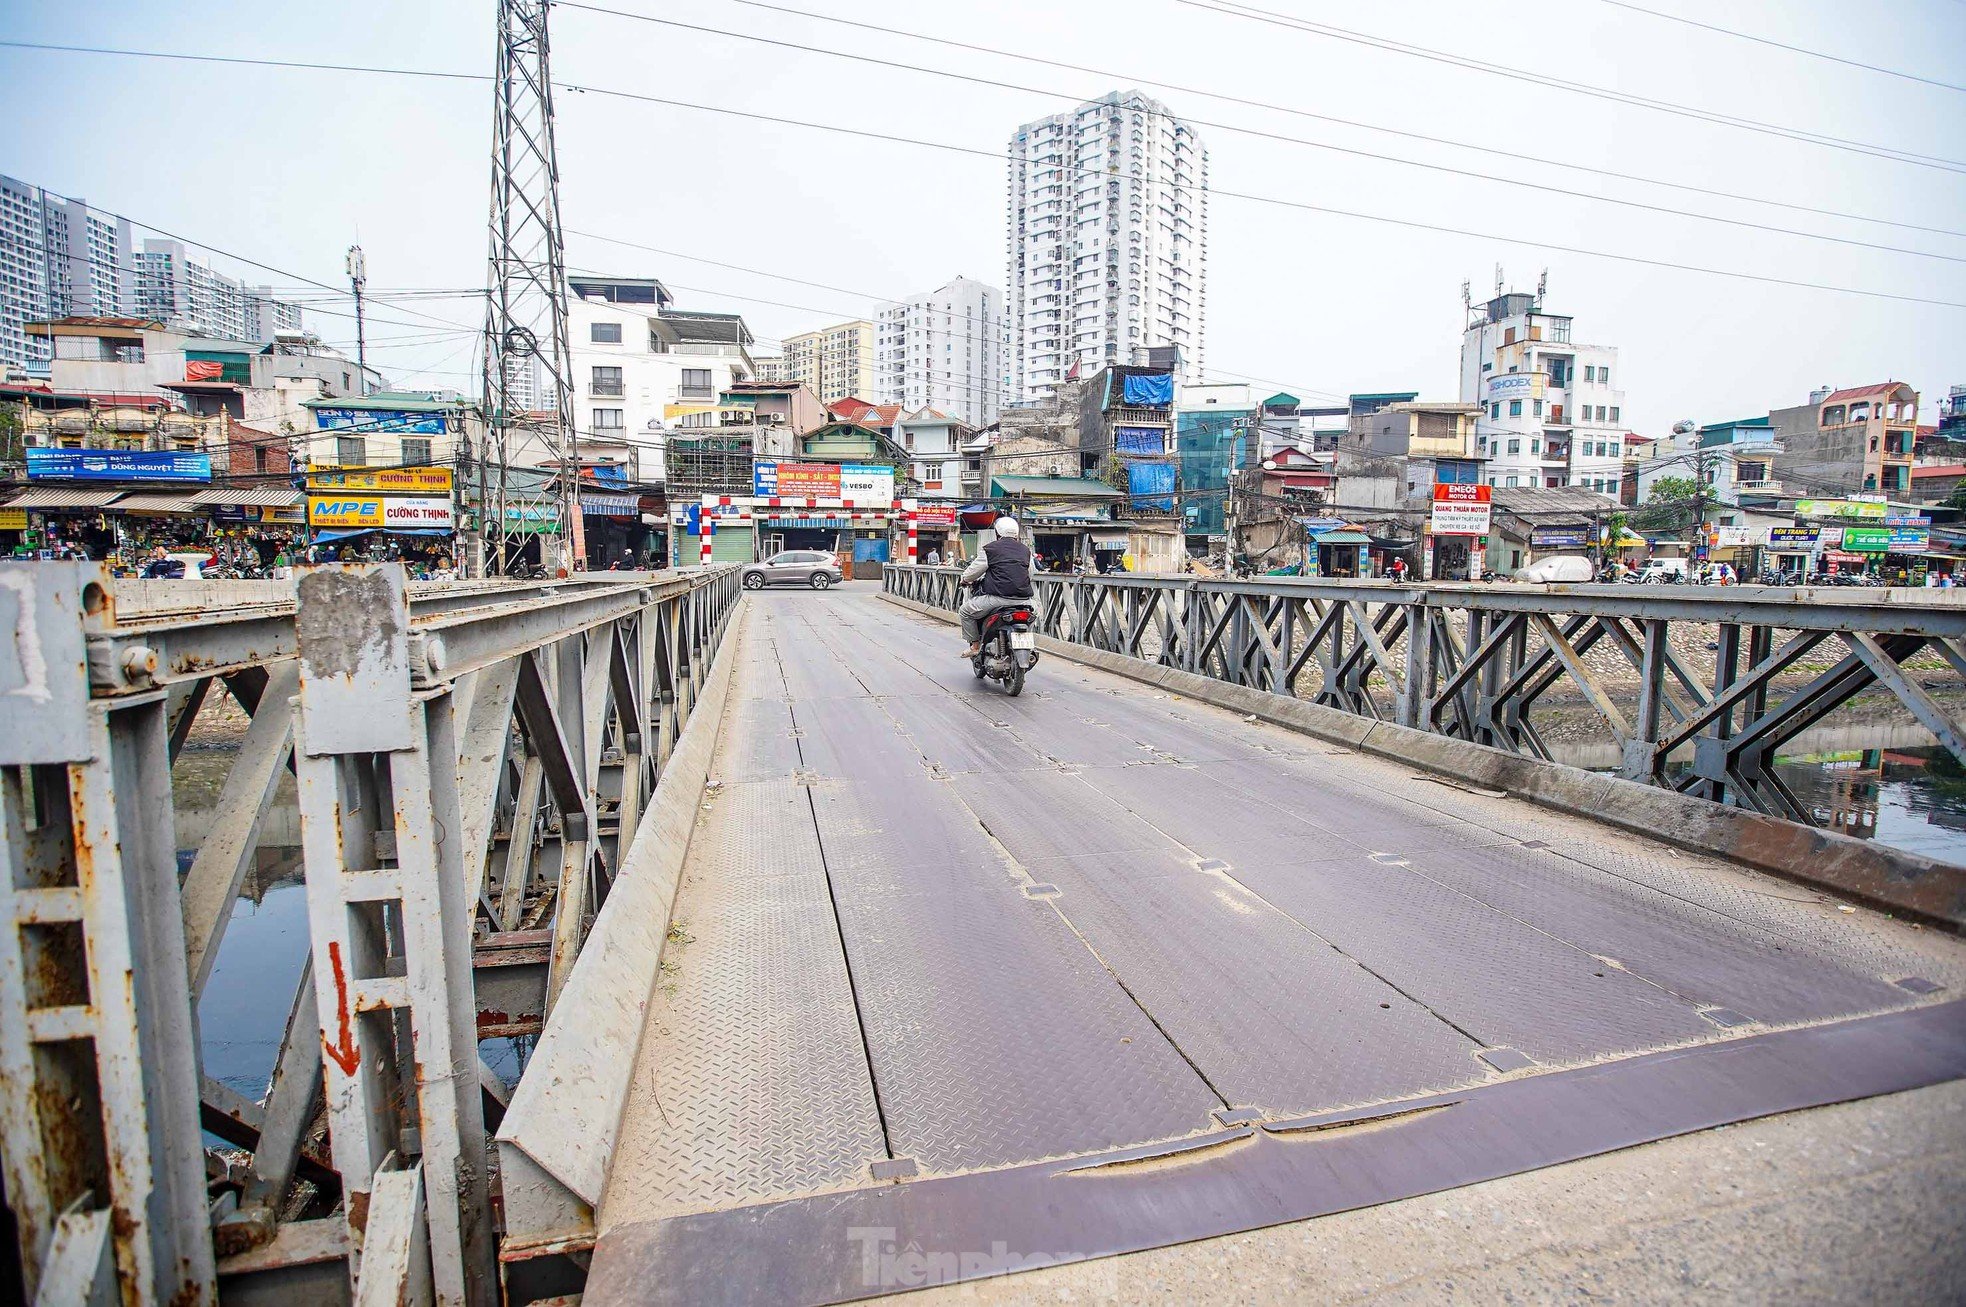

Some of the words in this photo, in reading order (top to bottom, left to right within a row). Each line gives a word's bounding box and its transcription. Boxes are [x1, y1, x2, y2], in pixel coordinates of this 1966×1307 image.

[1448, 485, 1477, 493] ENEOS
[314, 502, 378, 516] MPE
[387, 507, 419, 519] CƯỜNG
